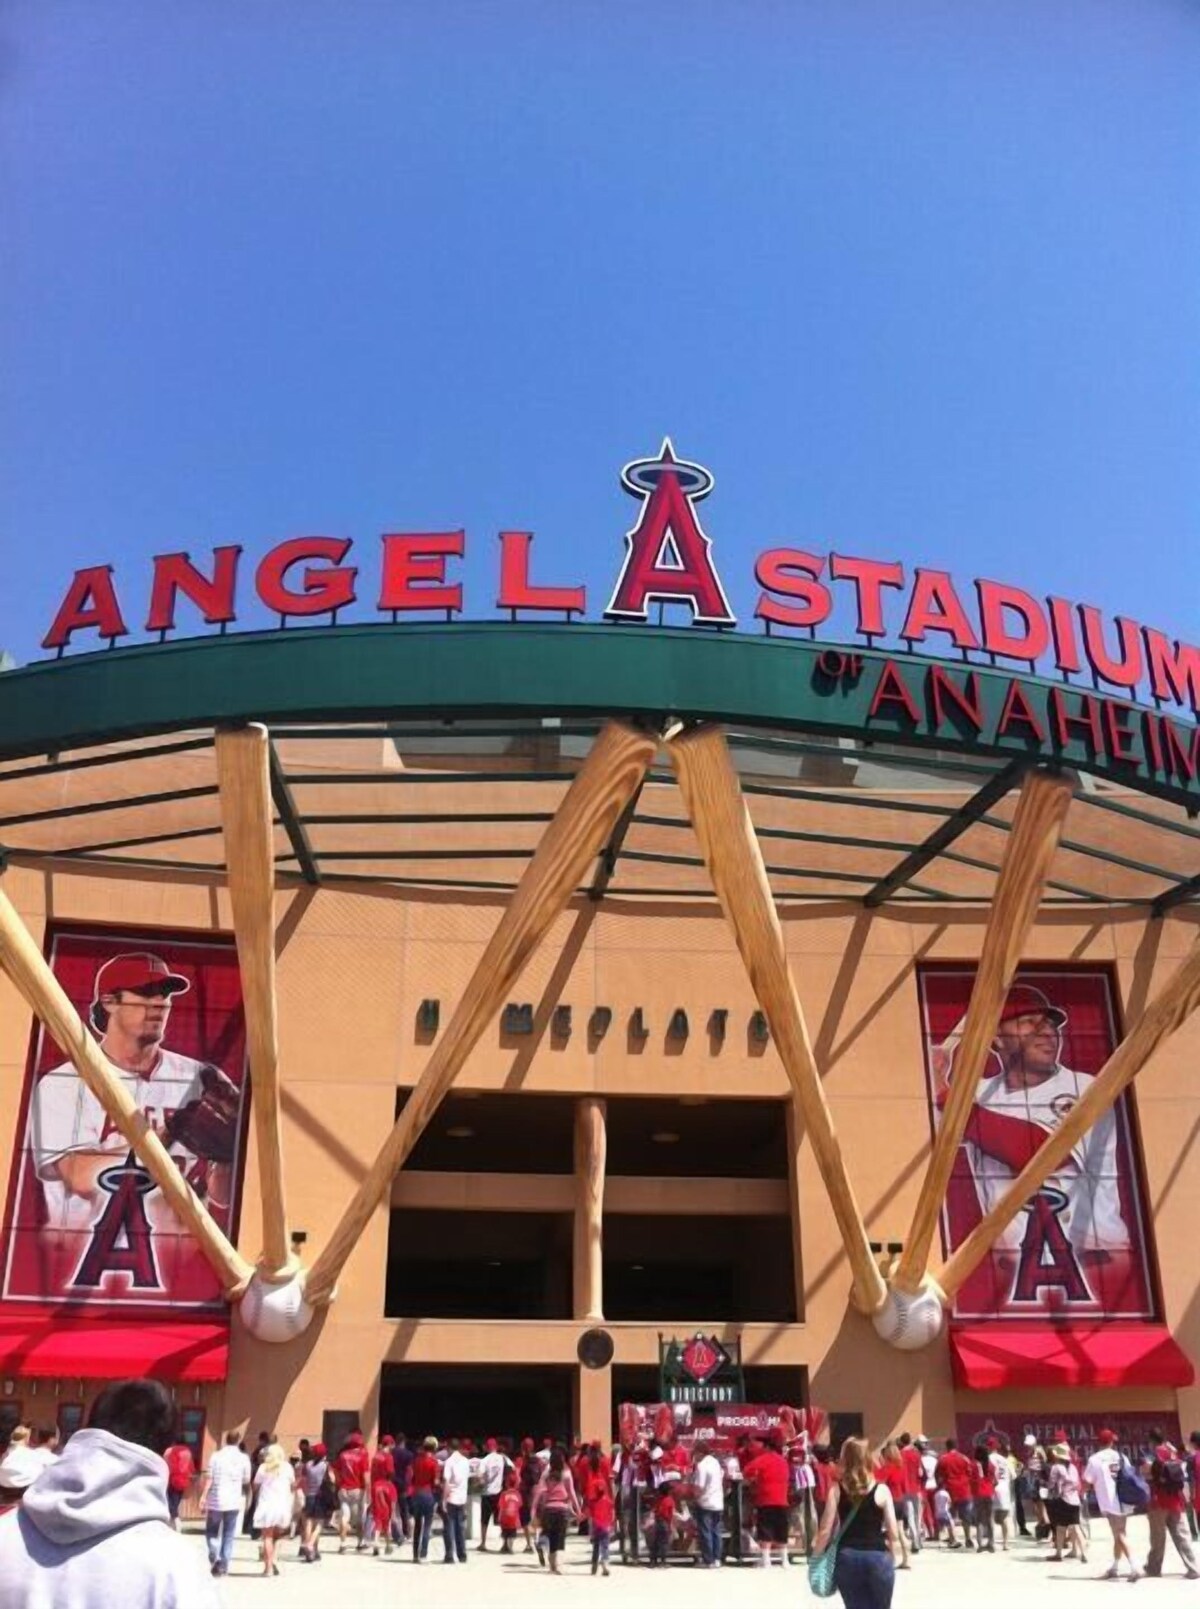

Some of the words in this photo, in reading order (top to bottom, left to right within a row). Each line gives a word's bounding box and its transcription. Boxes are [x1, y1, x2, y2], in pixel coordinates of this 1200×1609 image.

[41, 528, 587, 648] ANGEL
[754, 547, 1200, 715] STADIUM
[817, 648, 864, 680] OF
